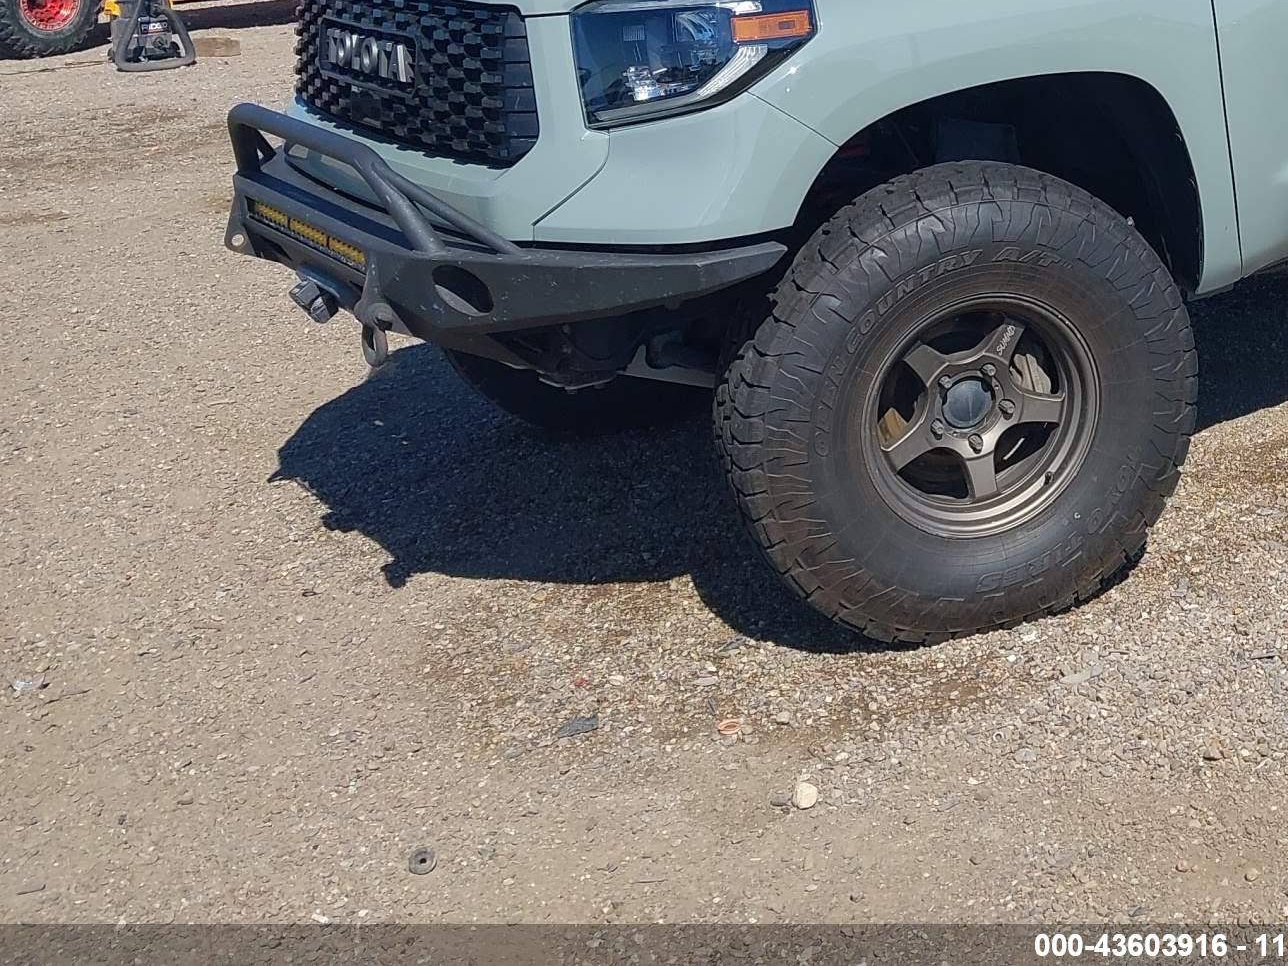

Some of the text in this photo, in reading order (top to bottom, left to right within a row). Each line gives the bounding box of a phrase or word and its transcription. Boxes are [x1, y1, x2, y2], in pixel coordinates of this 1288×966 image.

[326, 28, 415, 83] TOYOTA
[846, 247, 984, 355] COUNTRY
[991, 246, 1062, 268] A/T
